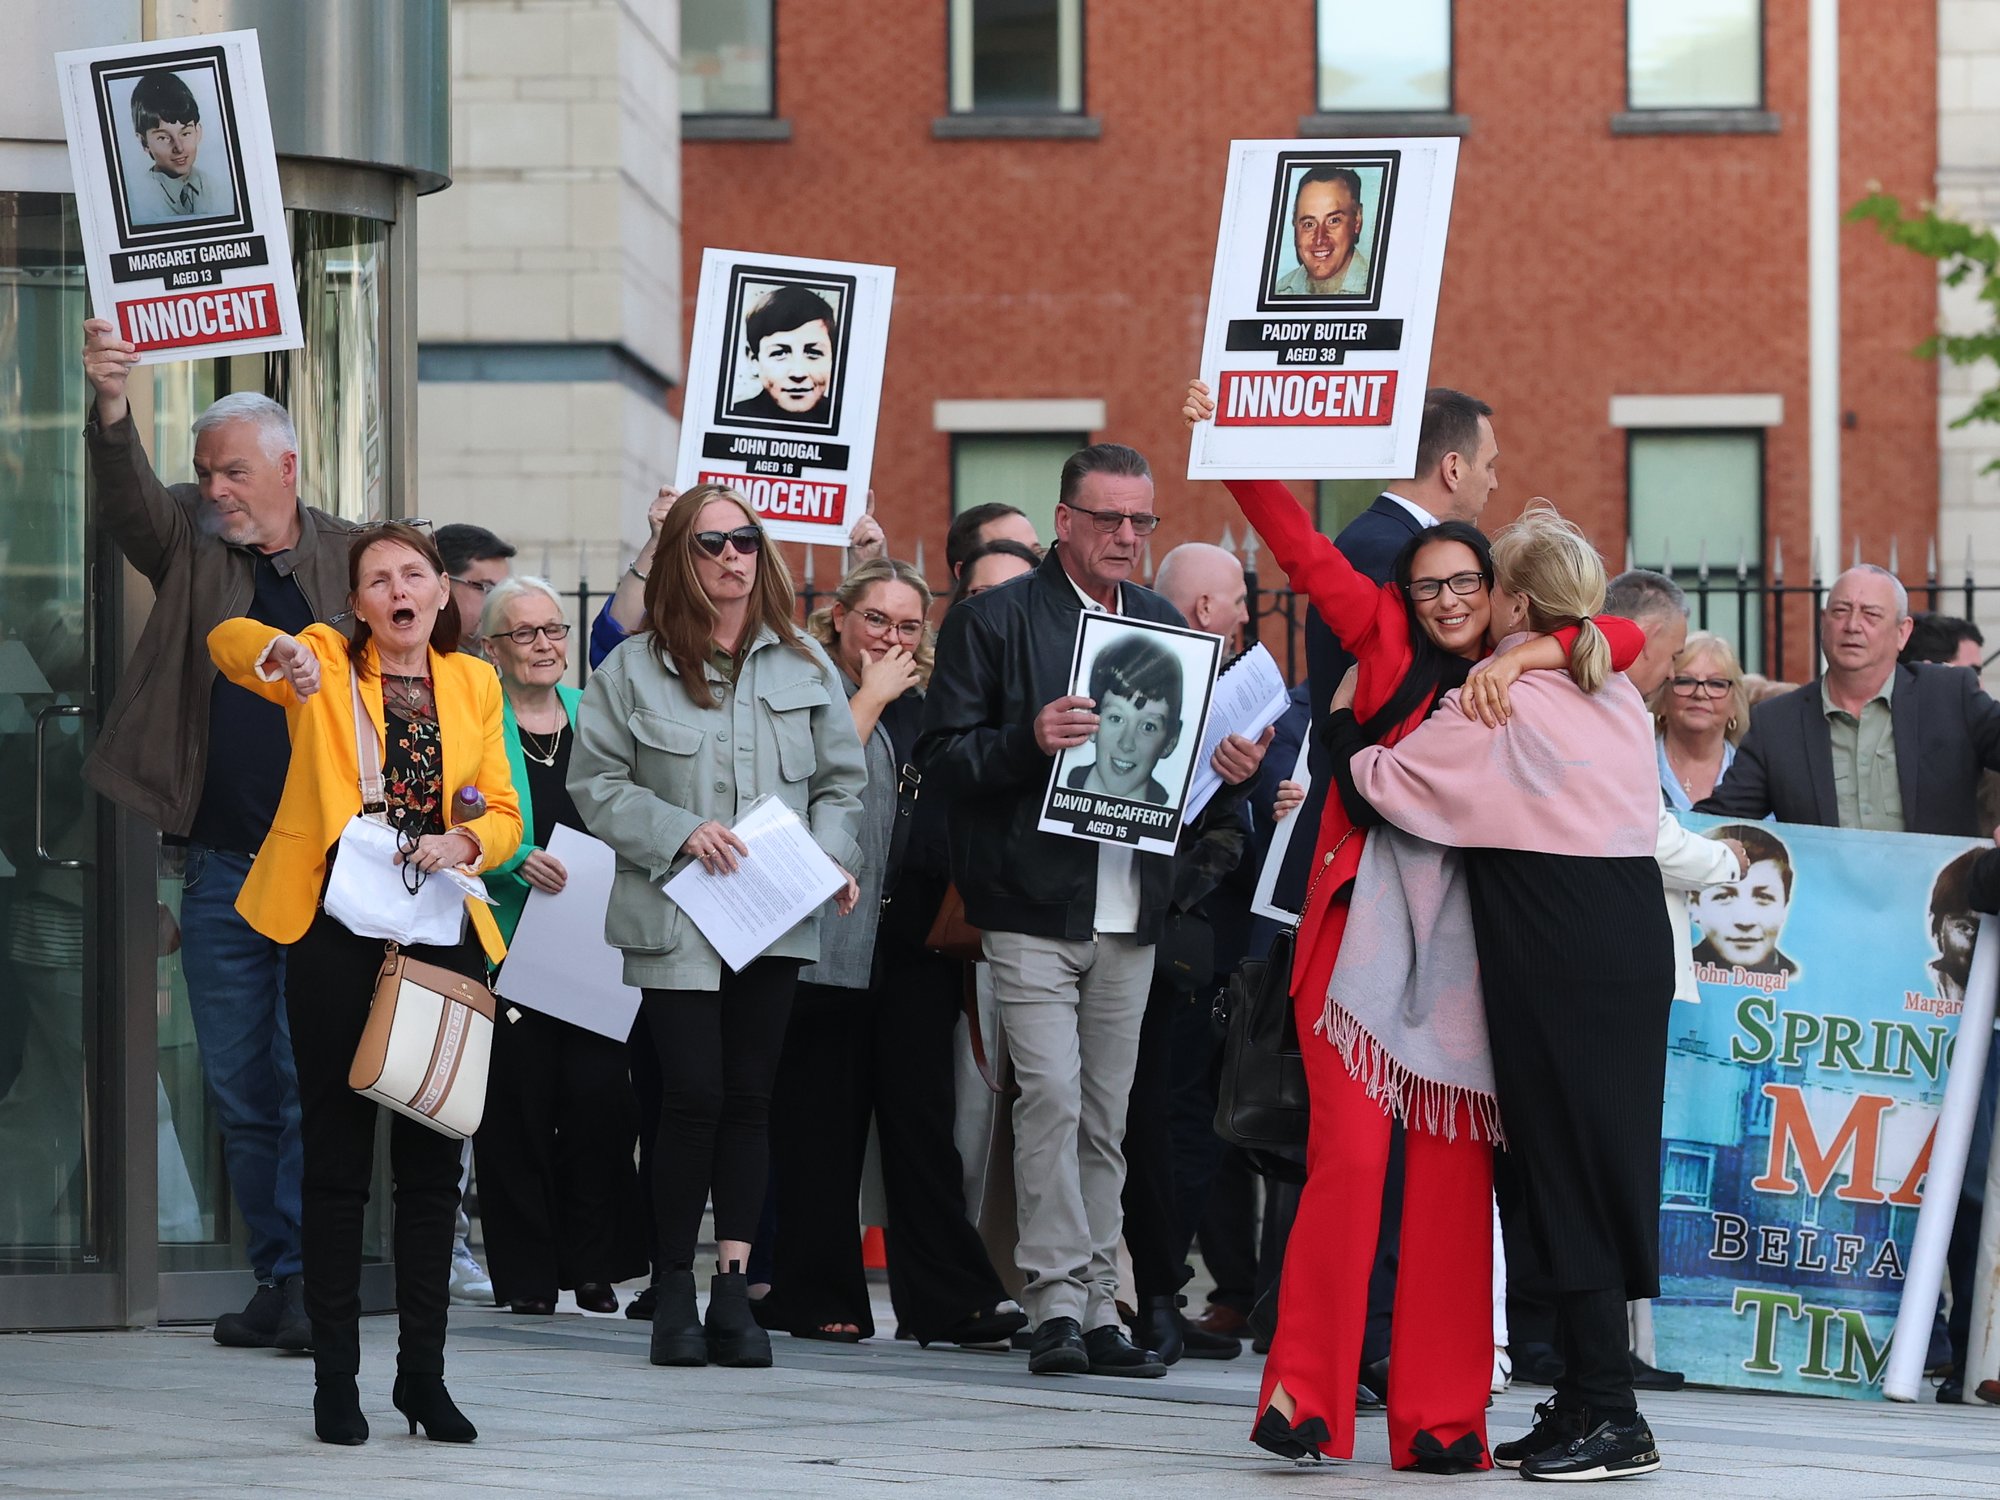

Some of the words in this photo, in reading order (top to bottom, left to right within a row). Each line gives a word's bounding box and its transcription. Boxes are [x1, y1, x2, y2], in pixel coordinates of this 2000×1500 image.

[127, 248, 196, 272] MARGARET
[199, 241, 251, 263] GARGAN
[172, 271, 199, 286] AGED
[200, 269, 213, 283] 13
[126, 289, 267, 344] INNOCENT
[1261, 323, 1311, 341] PADDY
[1313, 323, 1368, 341] BUTLER
[1285, 348, 1317, 362] AGED
[1319, 348, 1337, 362] 38
[1226, 375, 1388, 418] INNOCENT
[729, 437, 767, 456] JOHN
[769, 441, 823, 461] DOUGAL
[754, 460, 780, 473] AGED
[781, 462, 794, 474] 16
[1052, 792, 1092, 813] DAVID
[1093, 800, 1174, 828] McCAFFERTY
[1086, 820, 1113, 838] AGED
[1115, 825, 1128, 839] 15
[1733, 966, 1787, 993] Dougal
[1903, 991, 1964, 1018] Margar
[438, 1027, 459, 1077] ISLAND
[1732, 997, 1957, 1080] SPRIN
[1709, 1213, 1905, 1279] BELFA
